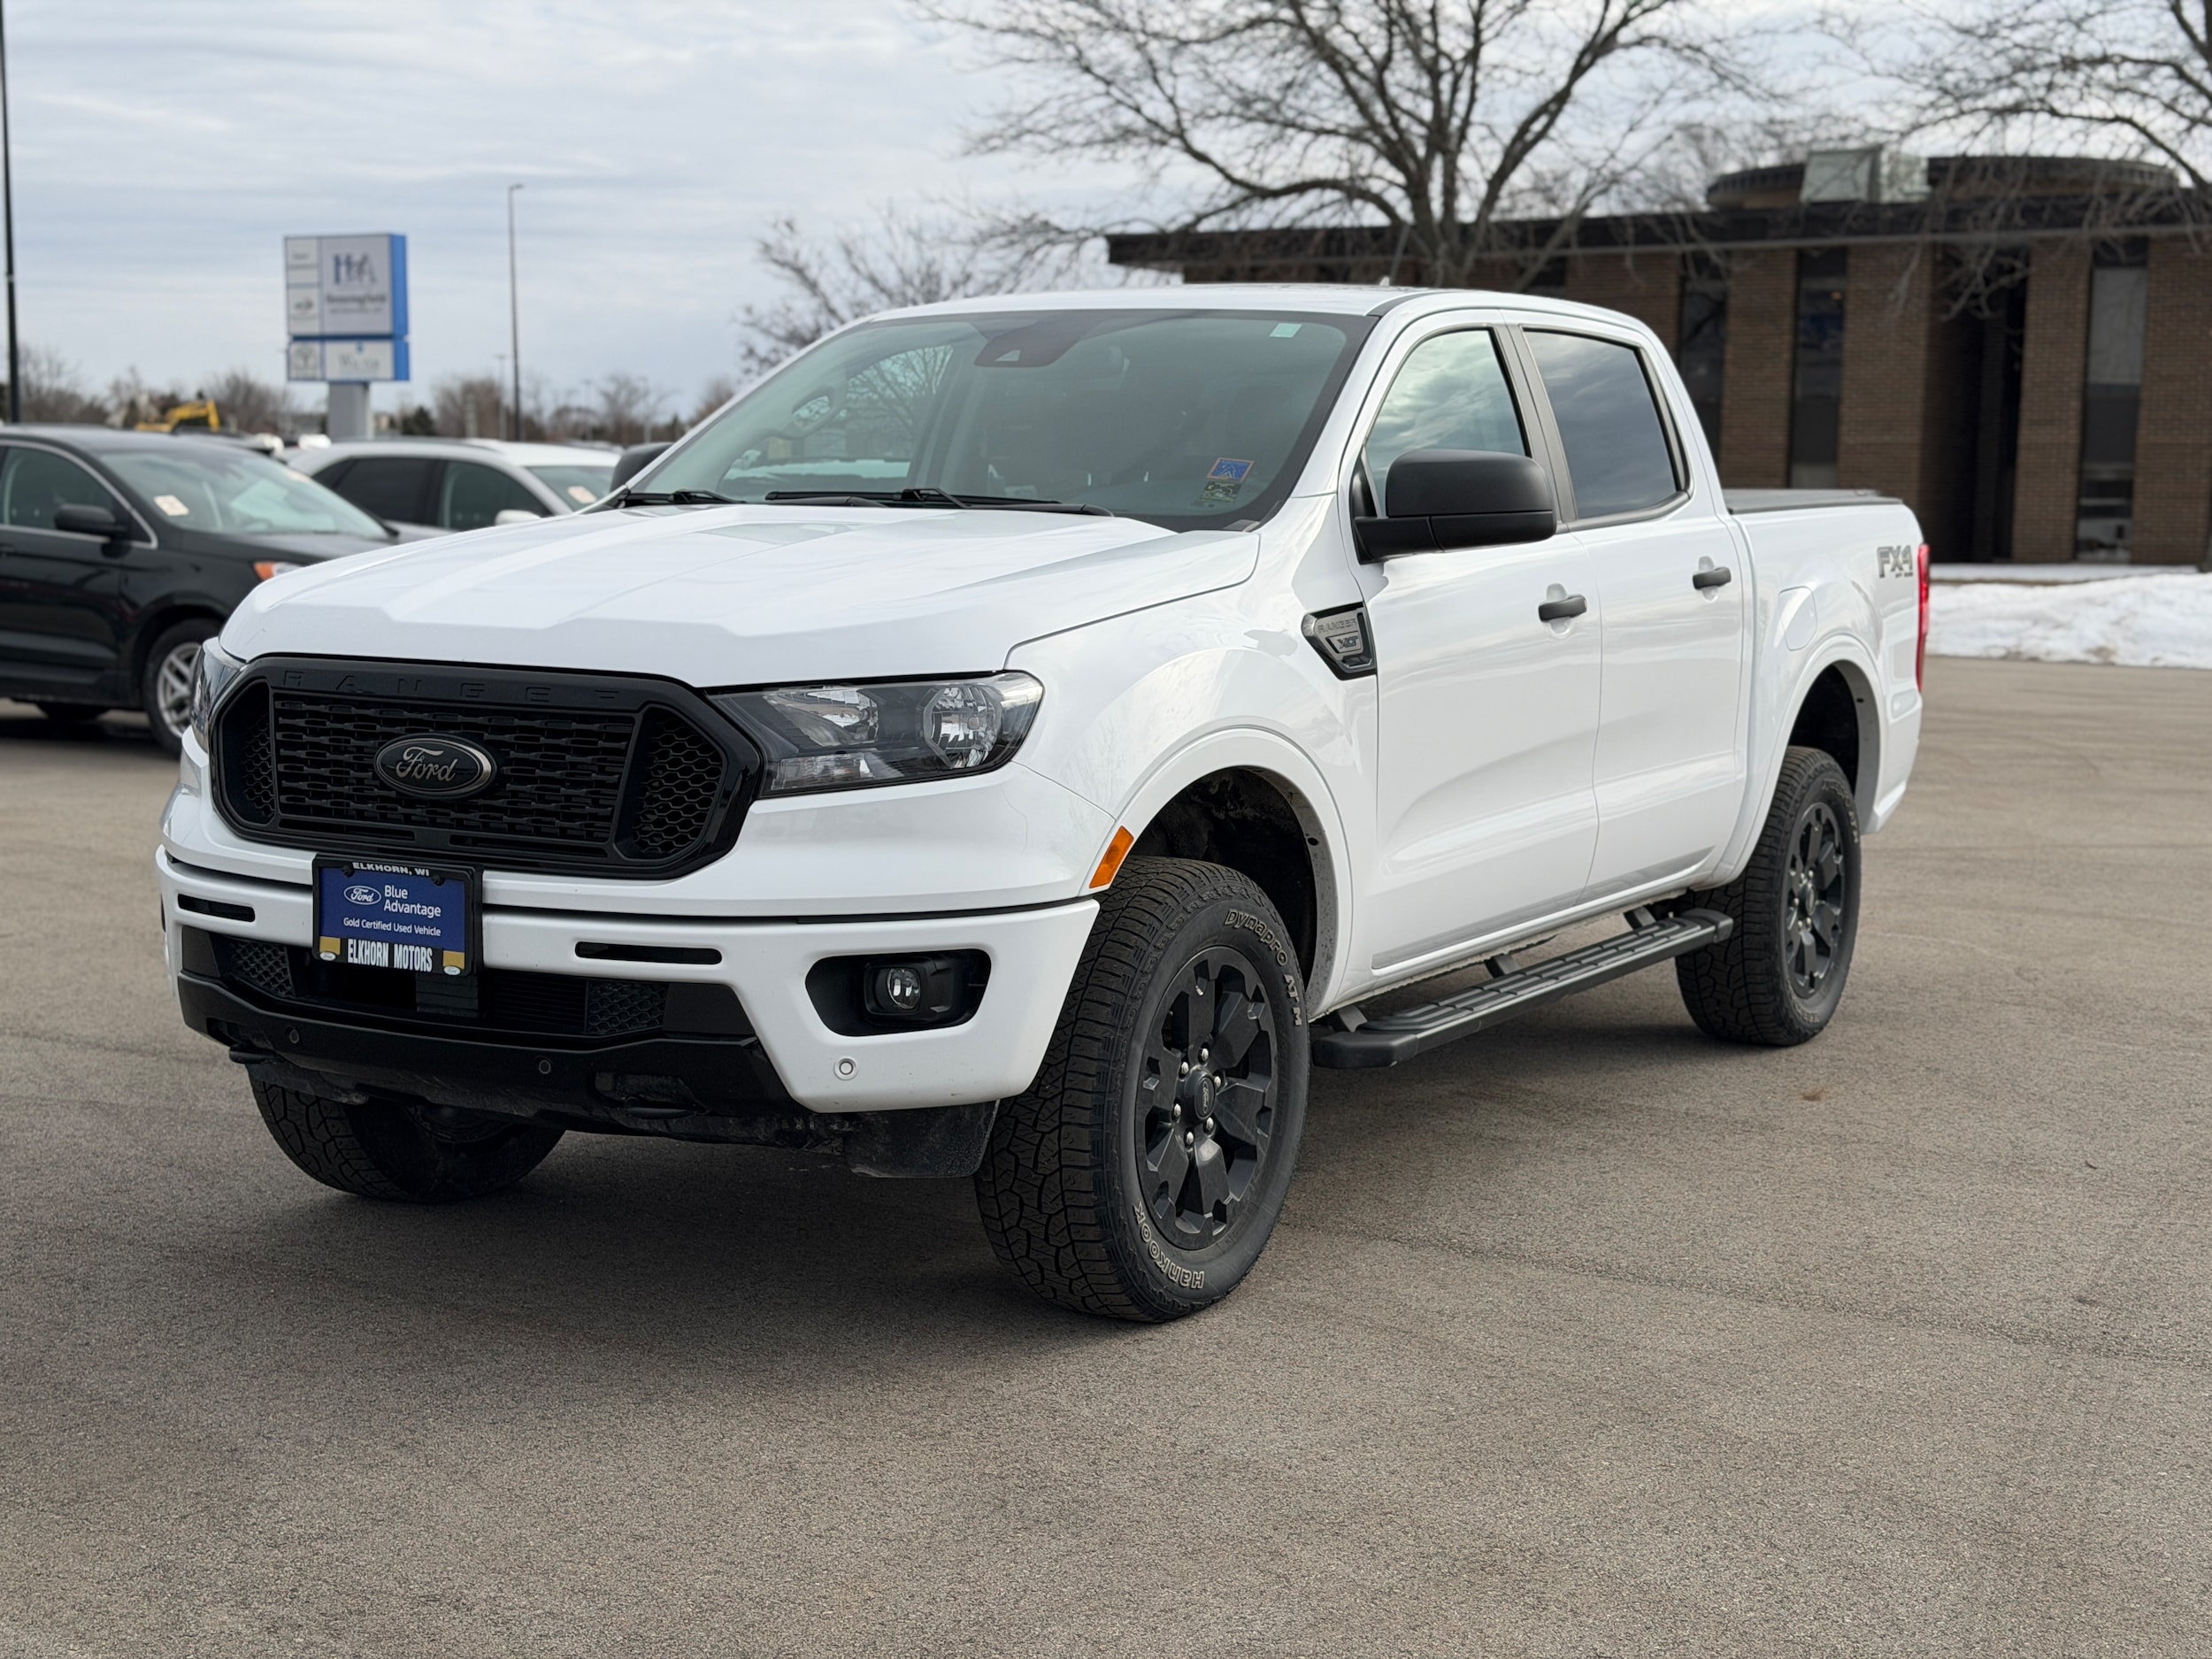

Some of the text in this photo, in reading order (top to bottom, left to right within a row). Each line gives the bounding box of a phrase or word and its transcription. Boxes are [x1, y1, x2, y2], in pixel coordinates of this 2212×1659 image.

[1877, 545, 1913, 578] FX4
[1317, 618, 1357, 634] RANGER
[396, 746, 458, 782] Ford
[352, 862, 412, 876] ELKHORN,
[350, 887, 373, 902] Ford
[384, 885, 408, 899] Blue
[383, 899, 442, 918] Advantage
[343, 917, 442, 937] Gold Certified Used Vehicle
[1224, 908, 1288, 966] Dynapro
[347, 938, 433, 972] ELKHORN MOTORS
